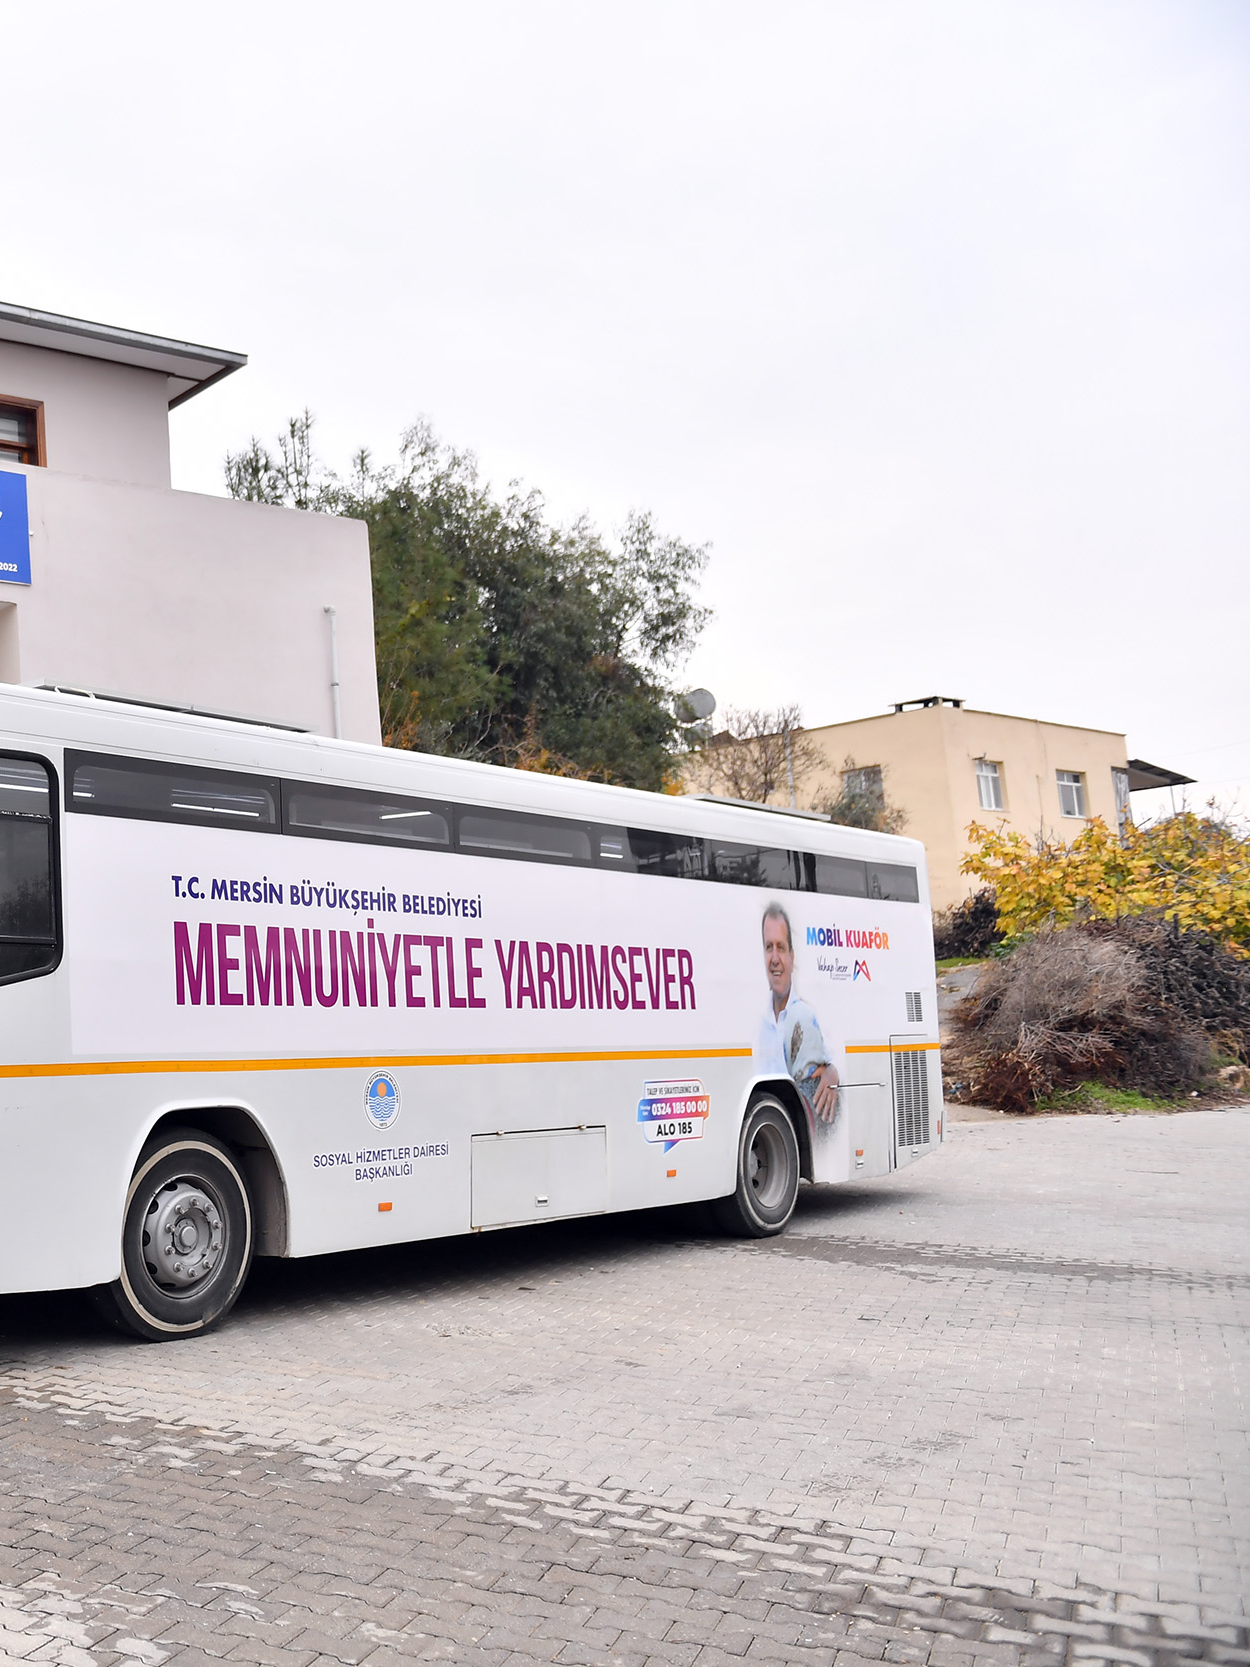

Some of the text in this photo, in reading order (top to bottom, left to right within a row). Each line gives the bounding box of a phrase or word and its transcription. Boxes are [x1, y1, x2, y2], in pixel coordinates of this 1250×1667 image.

[171, 875, 482, 919] T.C. MERSİN BÜYÜKŞEHİR BELEDİYESİ
[806, 923, 889, 950] MOBİL KUAFÖR
[173, 918, 696, 1010] MEMNUNİYETLE YARDIMSEVER
[651, 1102, 671, 1116] 0324
[672, 1101, 686, 1114] 185
[686, 1100, 696, 1113] 00
[697, 1100, 707, 1113] 00
[656, 1121, 693, 1137] ALO 185
[313, 1141, 449, 1168] SOSYAL HİZMETLER DAİRESİ
[355, 1161, 413, 1182] BAŞKANLIĞI
